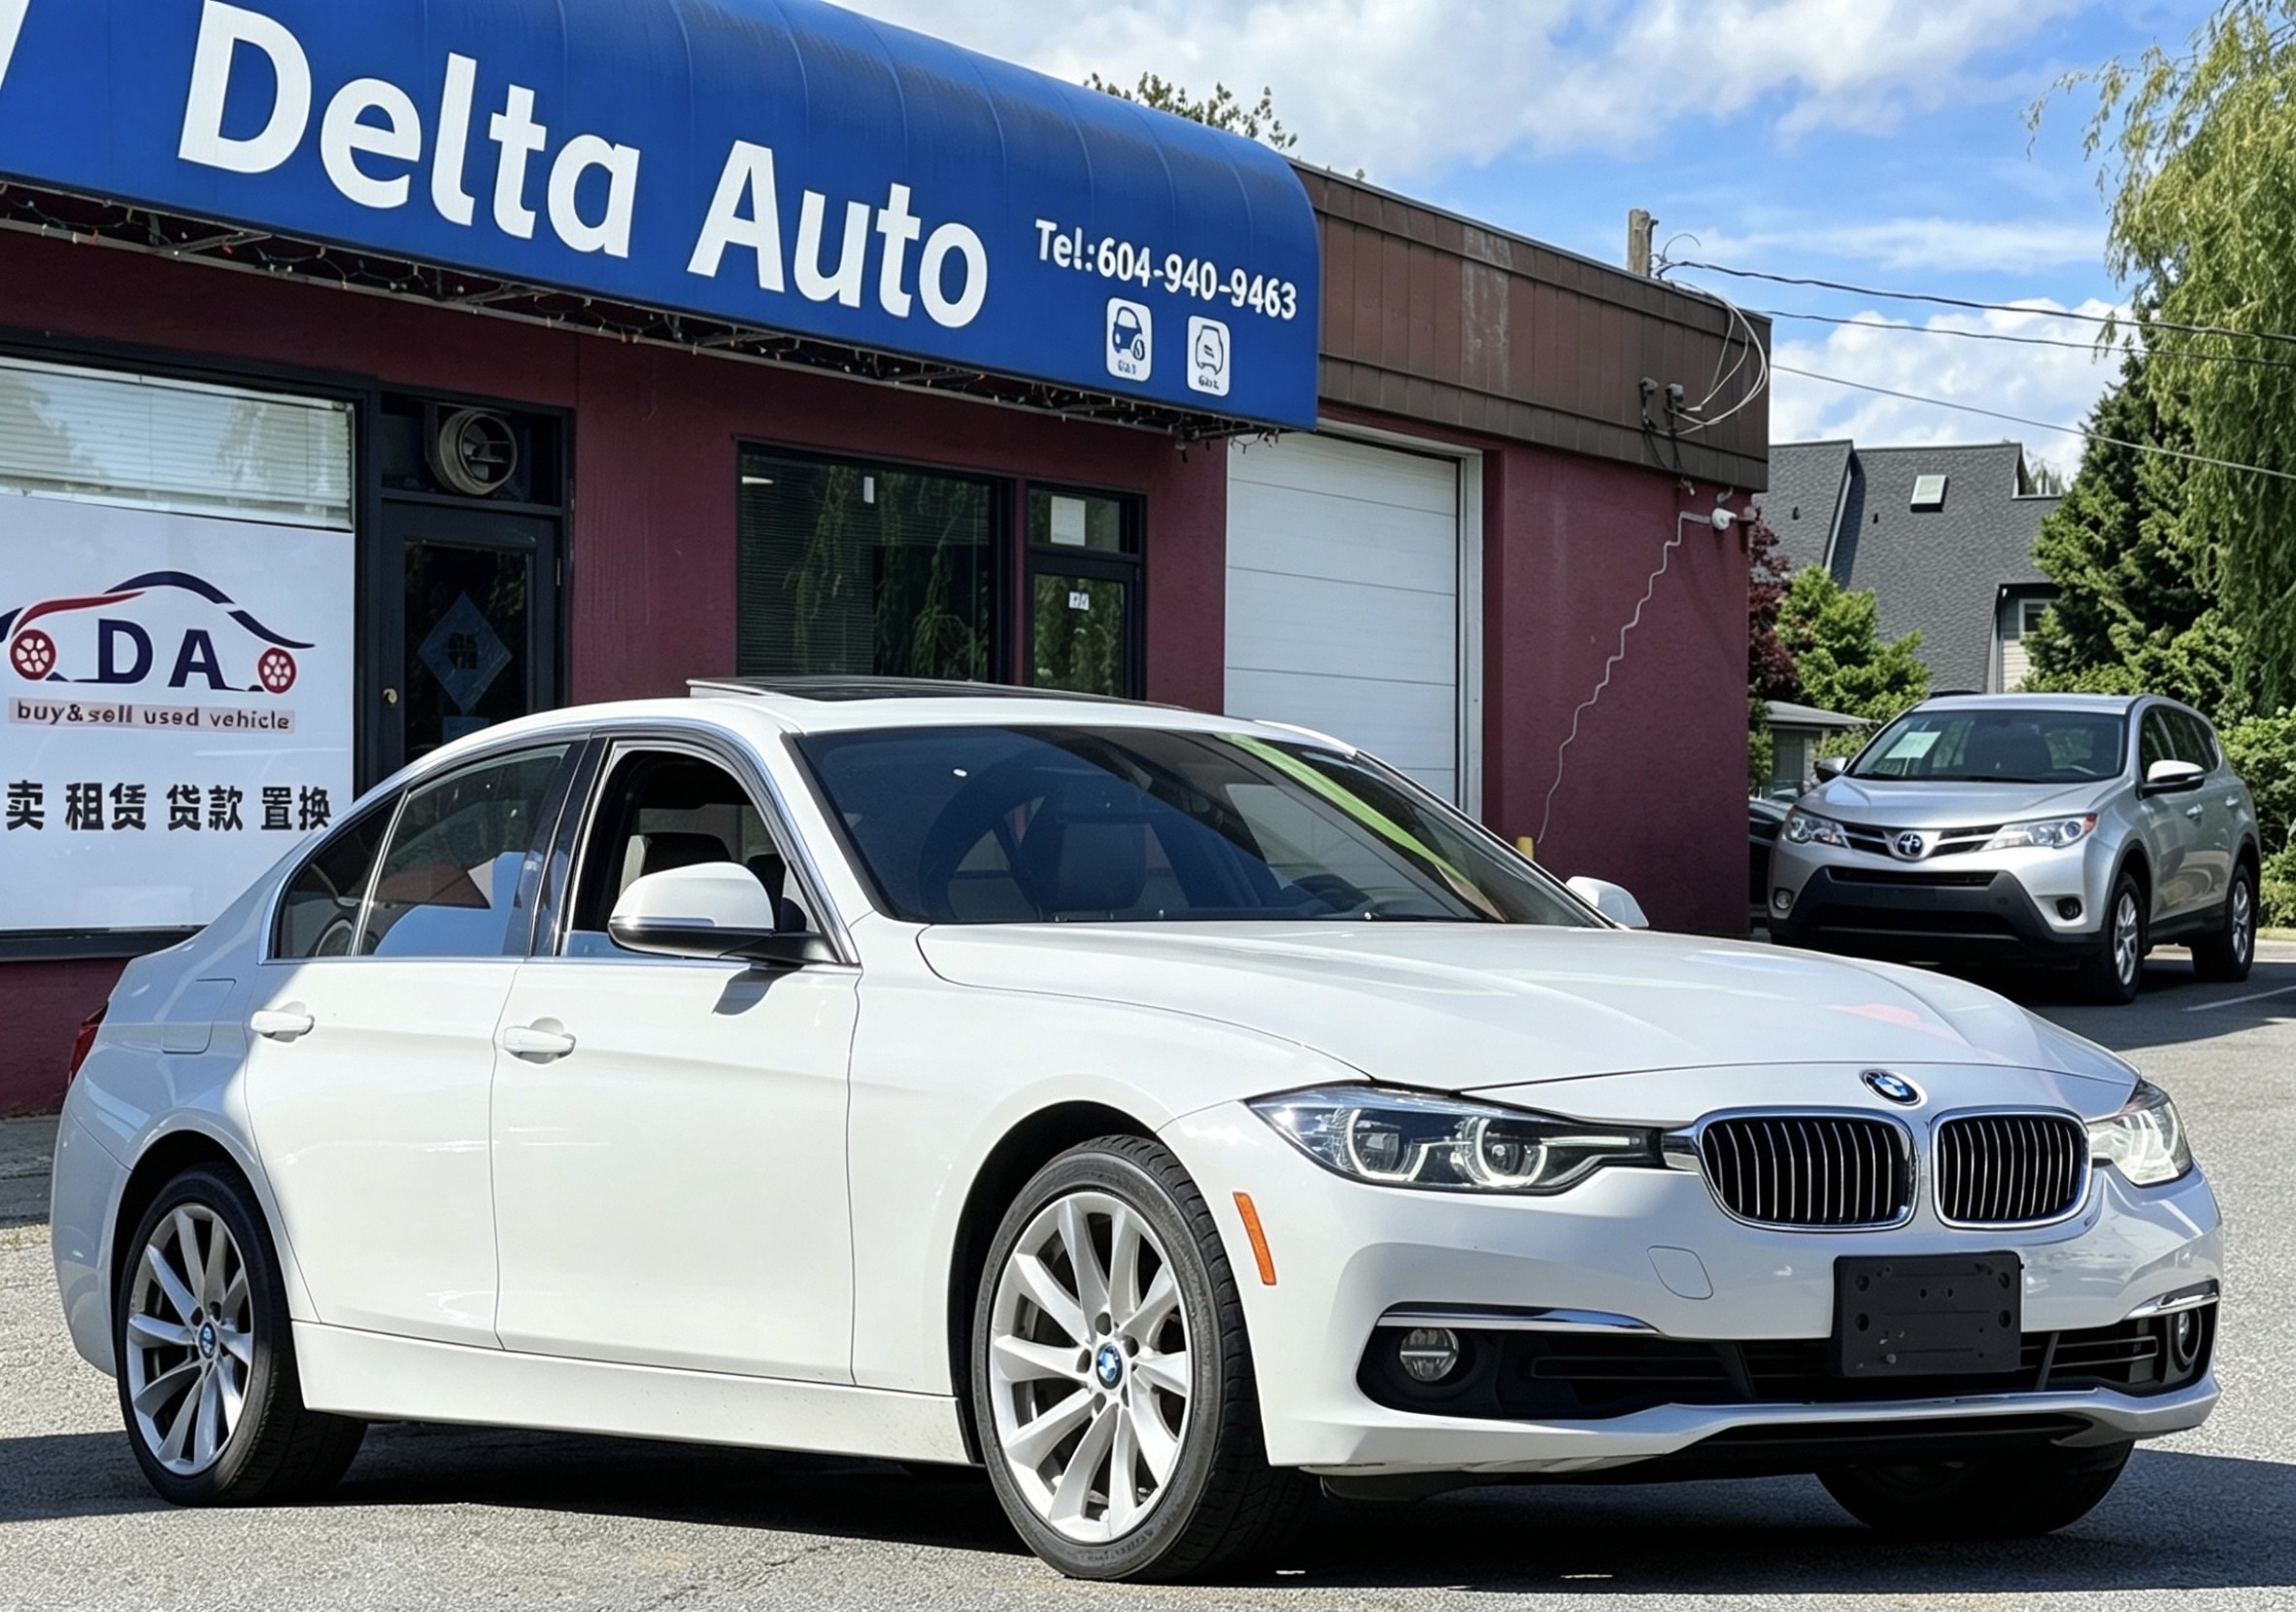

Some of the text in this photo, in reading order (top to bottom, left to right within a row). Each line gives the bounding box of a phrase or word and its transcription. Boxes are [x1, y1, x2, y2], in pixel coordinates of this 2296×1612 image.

[178, 0, 988, 328] Delta Auto
[144, 707, 199, 727] used
[209, 709, 290, 730] vehicle
[6, 779, 332, 832] 卖 租赁 贷款 置换
